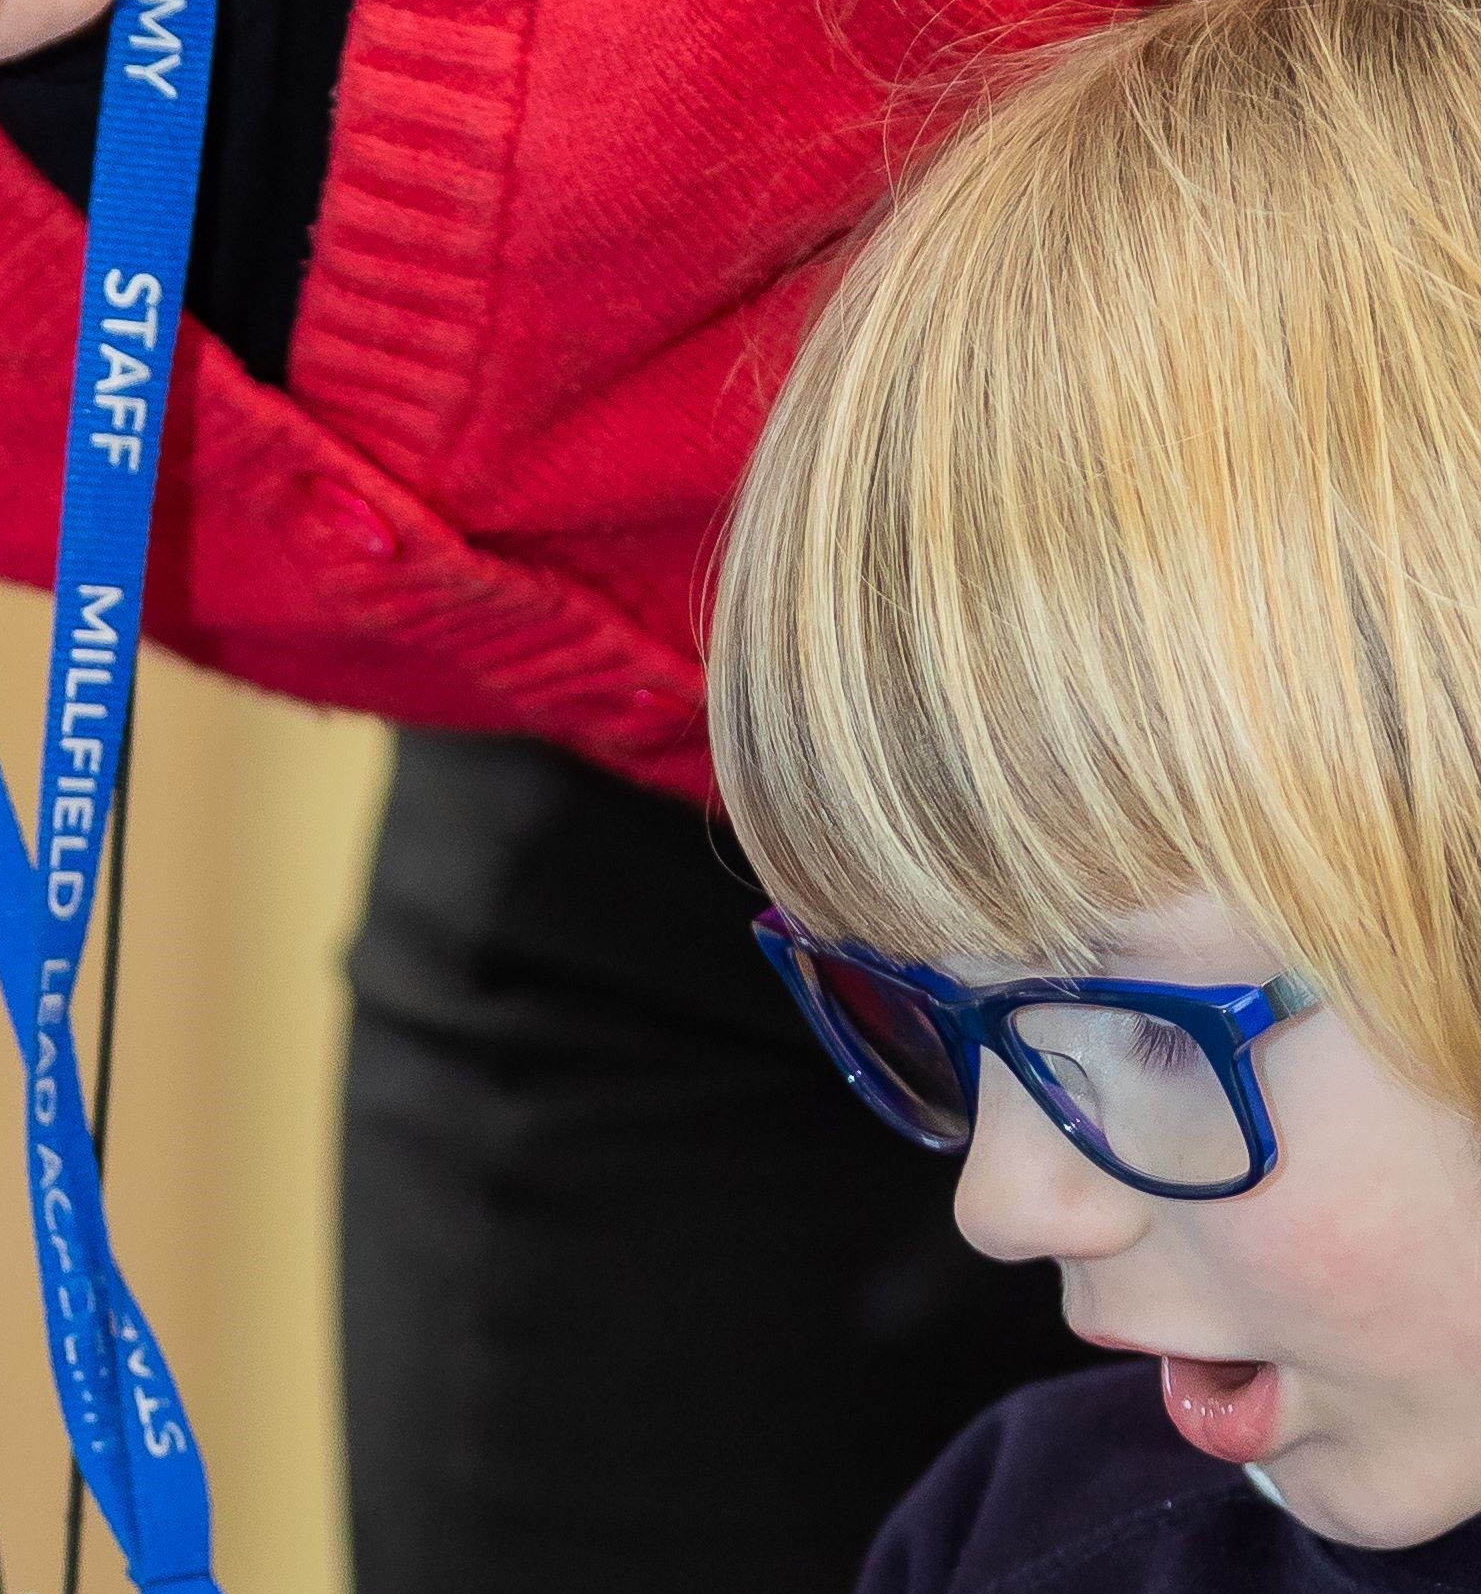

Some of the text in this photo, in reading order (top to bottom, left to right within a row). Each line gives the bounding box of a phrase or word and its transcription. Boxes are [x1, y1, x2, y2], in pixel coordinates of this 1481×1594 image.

[89, 267, 163, 473] STAFF
[48, 583, 125, 921] MILLFIELD
[34, 958, 71, 1128] LEAD
